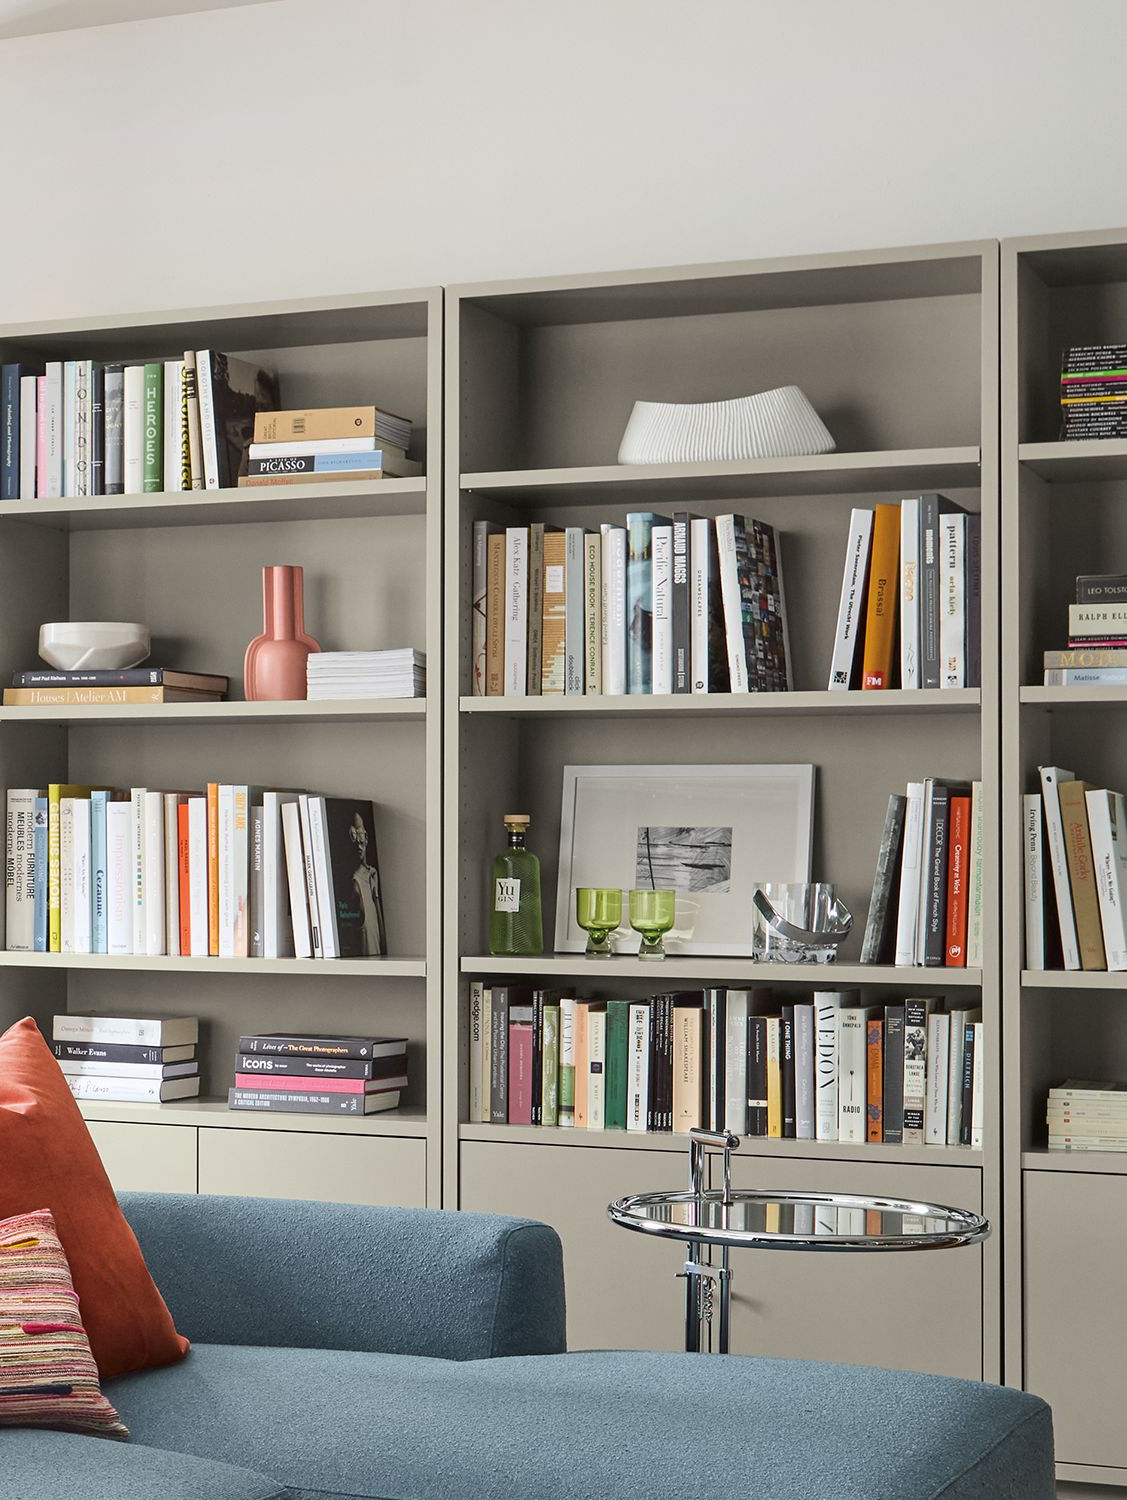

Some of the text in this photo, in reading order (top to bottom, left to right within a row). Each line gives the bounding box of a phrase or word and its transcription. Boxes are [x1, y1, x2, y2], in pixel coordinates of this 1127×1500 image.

[200, 361, 210, 400] DOROTHY
[76, 368, 87, 496] LONDON
[146, 388, 157, 465] HEROES
[260, 461, 306, 472] PICASSO
[675, 523, 686, 584] ARNAUD MAGGS
[948, 527, 957, 569] pattern
[657, 537, 668, 620] Pacific Natural
[1087, 588, 1102, 596] LEO
[512, 582, 520, 622] Gathering
[1078, 613, 1108, 621] RALPH
[31, 691, 127, 704] Houses Atelier AM
[50, 803, 60, 856] GENIUS
[1029, 833, 1037, 852] Penn
[27, 812, 35, 899] modern FURNITURE
[953, 845, 962, 872] Creativity
[1029, 855, 1038, 879] Beyond
[1079, 854, 1089, 881] Gorky
[7, 858, 15, 888] MÖBEL
[113, 834, 125, 922] Impressionism
[97, 870, 105, 917] Cezanne
[498, 883, 515, 896] Yu
[1030, 881, 1039, 903] Beauty
[472, 989, 480, 1042] at-edge.com
[67, 1048, 107, 1057] Walker Evans
[242, 1058, 273, 1070] icons
[313, 1047, 349, 1055] Photographers
[843, 1106, 861, 1114] RADIO
